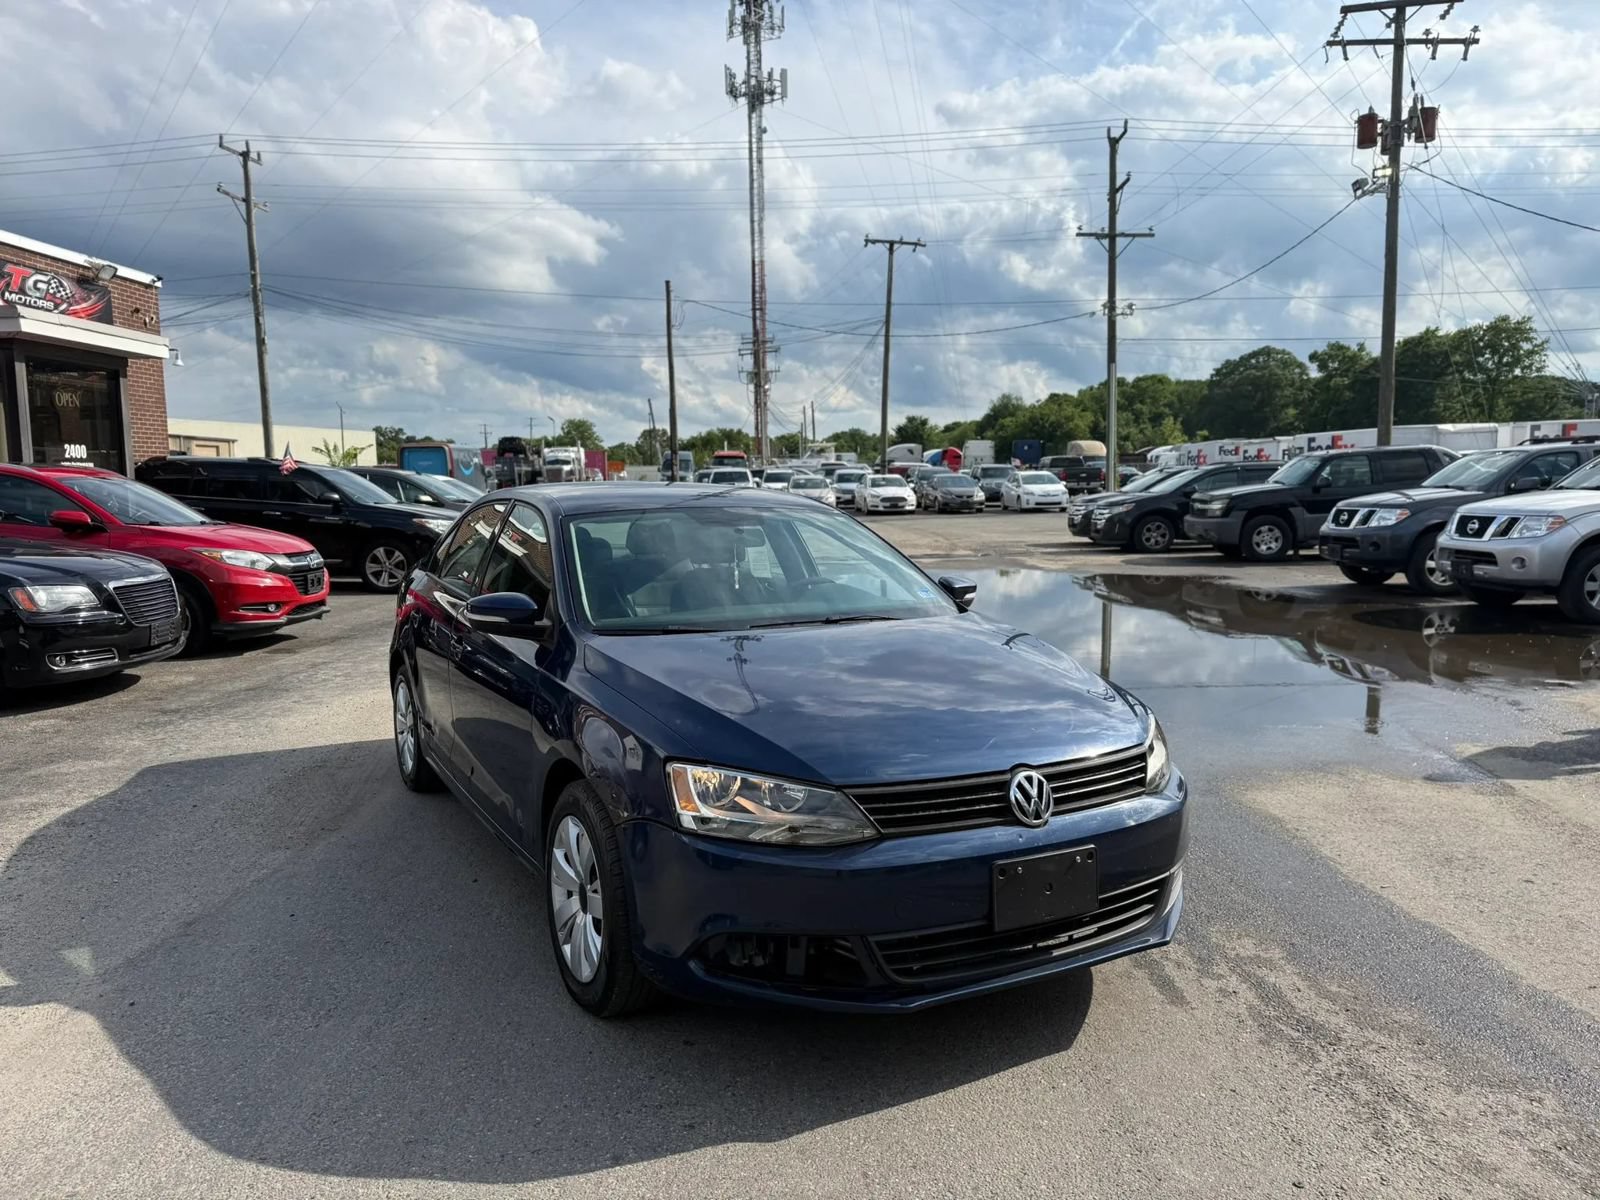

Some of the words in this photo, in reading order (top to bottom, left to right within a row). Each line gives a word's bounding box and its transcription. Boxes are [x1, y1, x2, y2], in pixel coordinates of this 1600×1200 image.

[4, 291, 54, 310] MOTORS
[55, 391, 80, 407] OPEN
[64, 443, 87, 458] 2400
